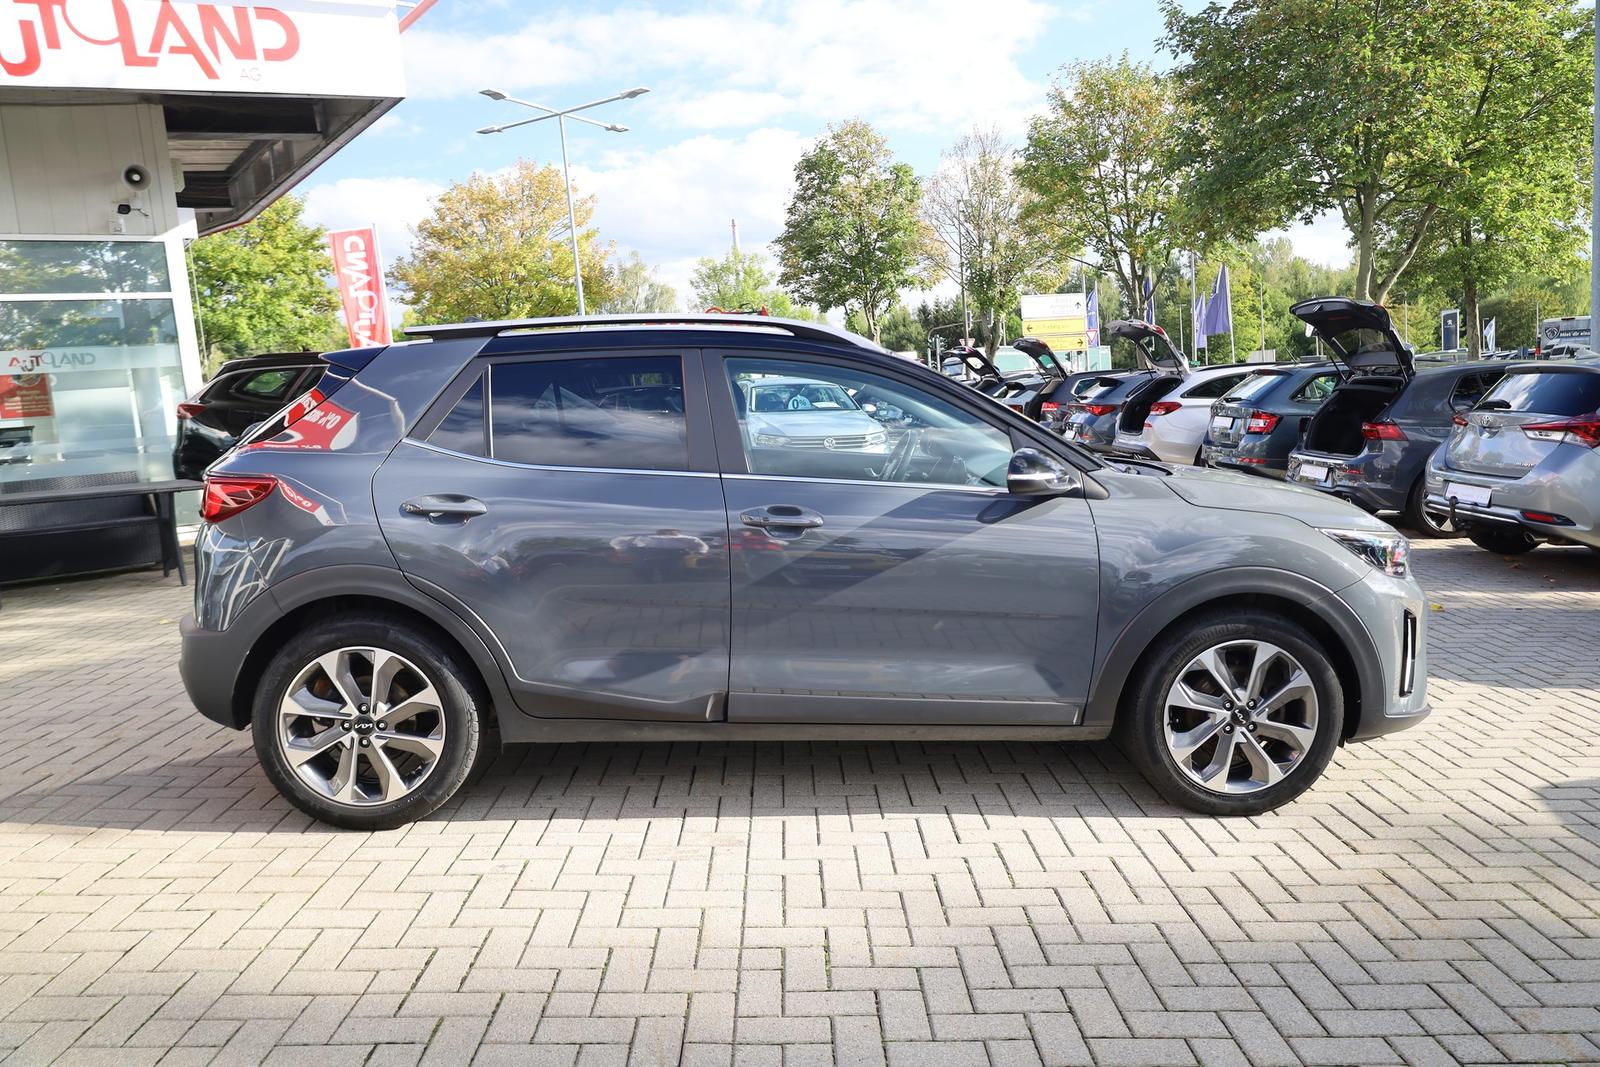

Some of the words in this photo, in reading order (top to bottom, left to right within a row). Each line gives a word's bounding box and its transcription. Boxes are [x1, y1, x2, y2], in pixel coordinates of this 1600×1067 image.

[0, 0, 300, 80] UTOLAND
[8, 352, 96, 372] AUTOLAND
[792, 399, 806, 409] 0%
